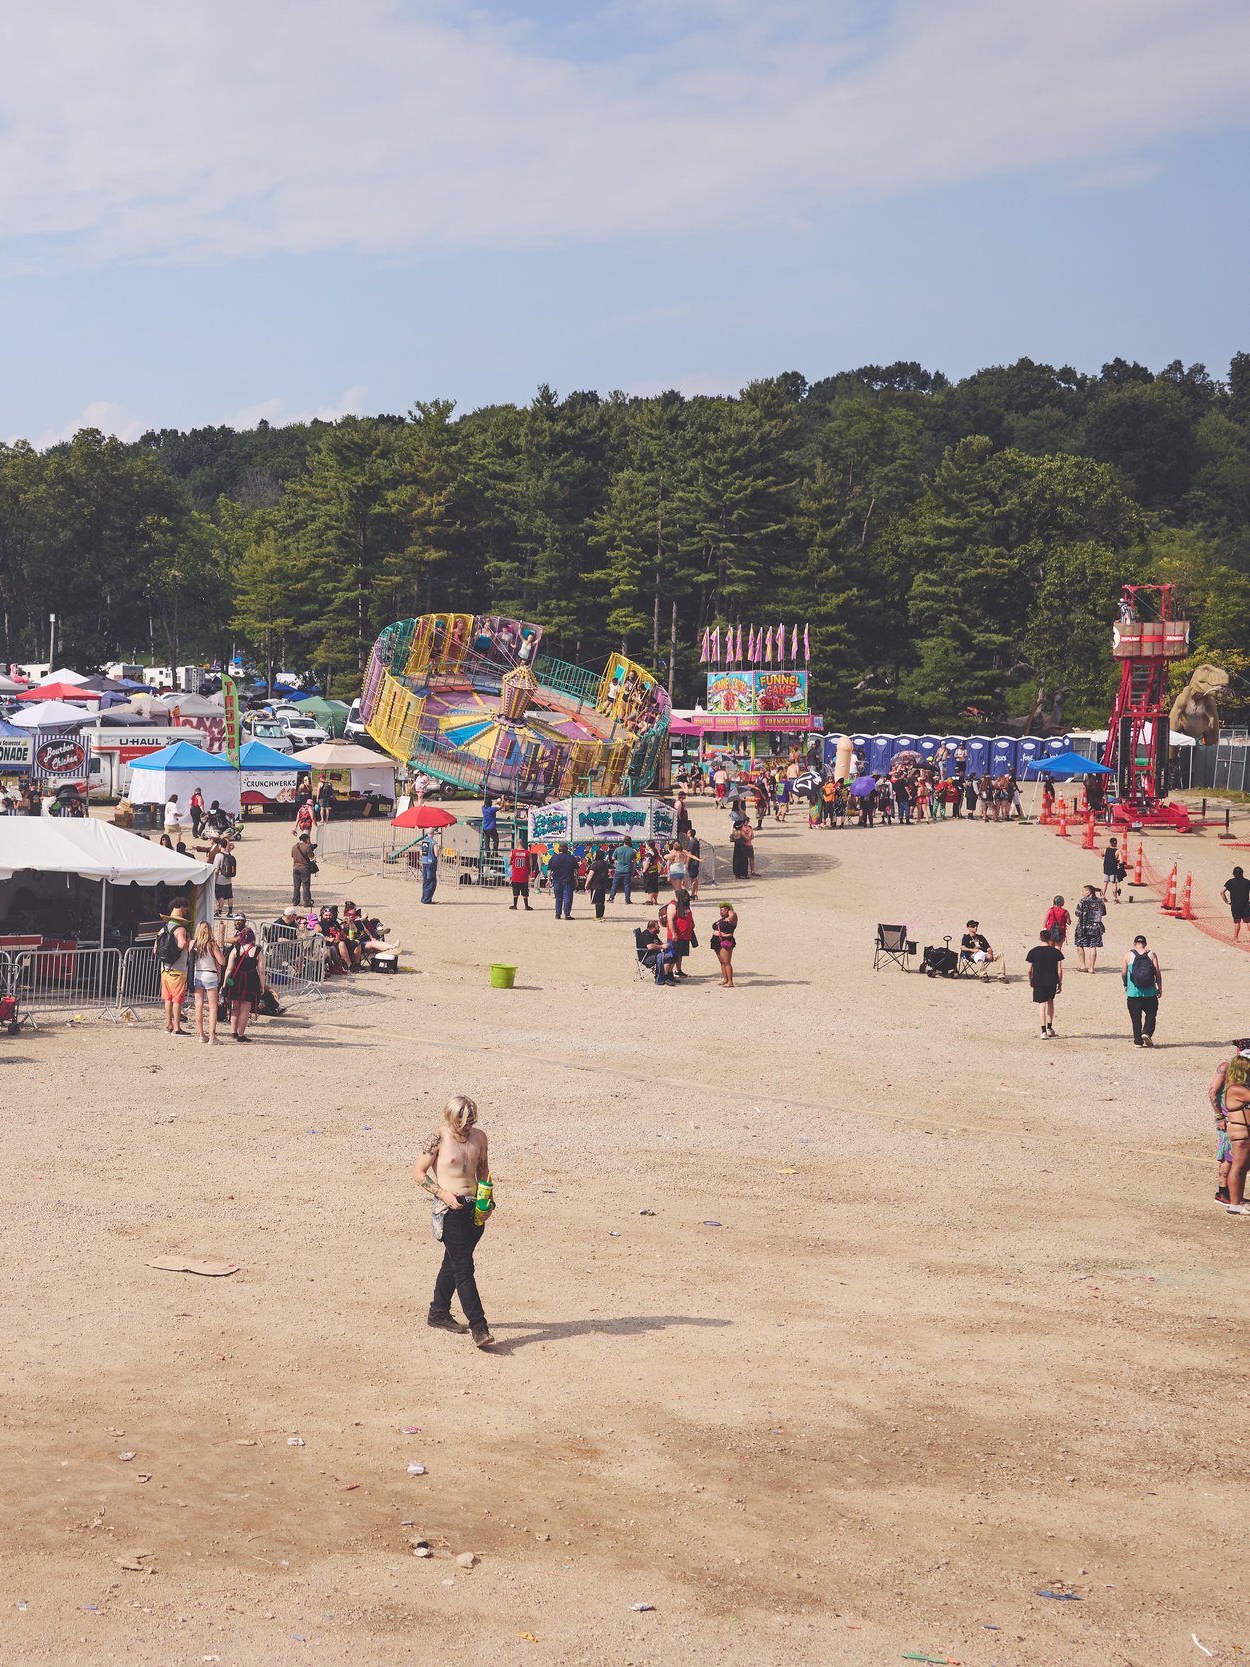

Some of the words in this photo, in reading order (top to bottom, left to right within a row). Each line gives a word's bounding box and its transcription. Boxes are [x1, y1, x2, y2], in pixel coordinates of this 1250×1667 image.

[760, 674, 801, 687] FUNNEL
[765, 685, 797, 697] CAKES
[765, 718, 790, 726] FRENCH
[791, 718, 809, 726] FRIES
[119, 738, 162, 746] U-HAUL
[43, 743, 75, 762] Bourbon
[51, 754, 78, 770] Chicken
[246, 780, 297, 788] CRUNCHWERKS
[579, 811, 611, 828] ACES
